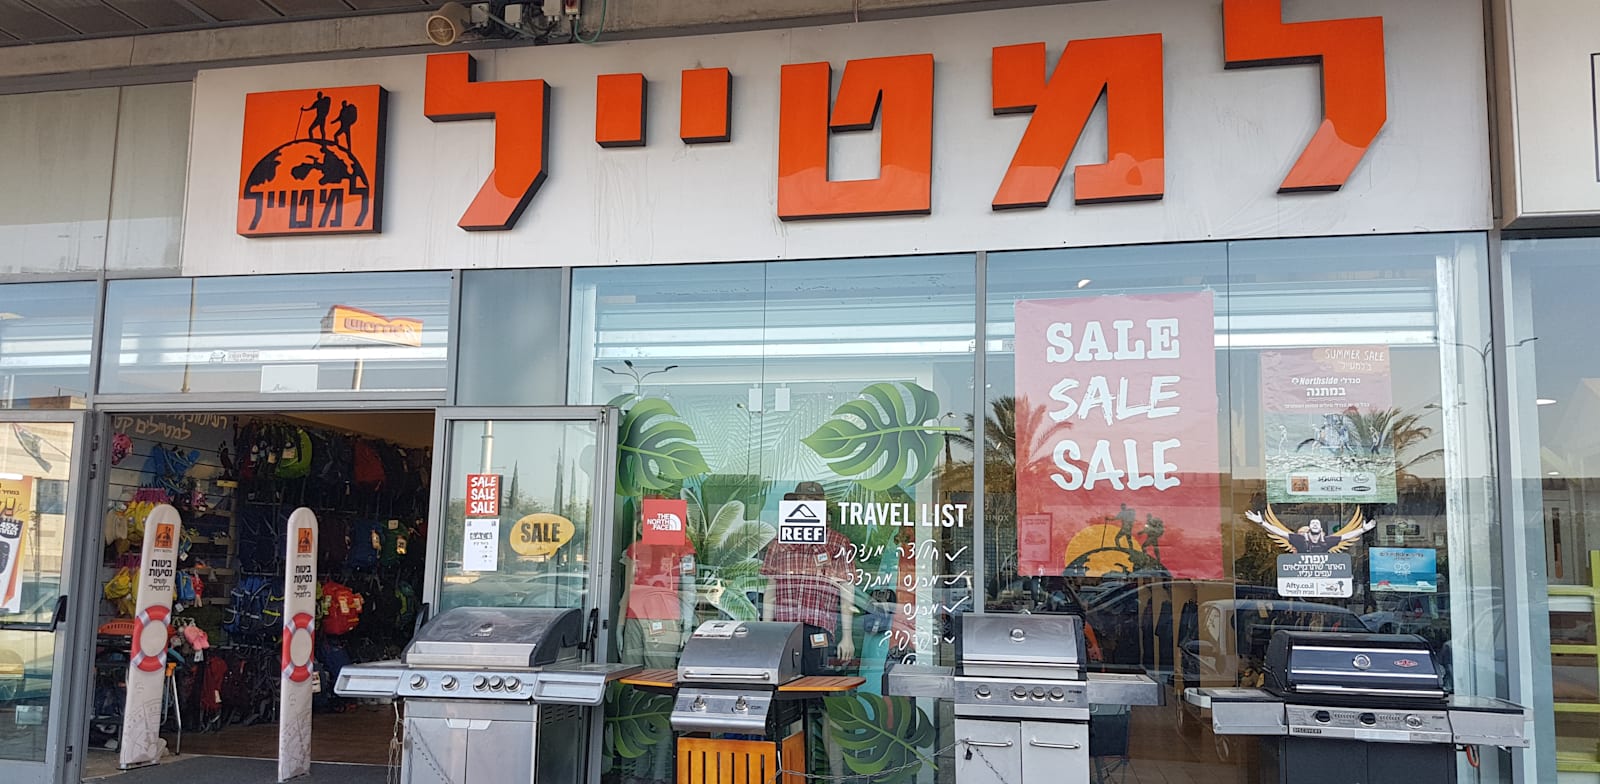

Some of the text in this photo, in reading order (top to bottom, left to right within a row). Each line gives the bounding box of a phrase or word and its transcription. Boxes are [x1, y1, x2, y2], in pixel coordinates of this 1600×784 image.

[424, 0, 1388, 229] למטייל
[243, 176, 369, 231] למטייל
[1046, 318, 1181, 363] SALE
[1325, 348, 1385, 361] SUMMER SALE
[1299, 376, 1339, 386] Northside
[1306, 387, 1346, 396] במתנה
[1049, 375, 1181, 426] SALE
[1050, 438, 1181, 491] SALE
[471, 476, 497, 488] SALE
[471, 488, 496, 501] SALE
[470, 501, 495, 514] SALE
[838, 502, 967, 527] TRAVEL LIST
[520, 523, 560, 543] SALE
[781, 527, 824, 541] REEF
[151, 559, 172, 567] ביטוח
[295, 565, 311, 573] ביטוח
[148, 568, 173, 577] נסיעות
[293, 574, 312, 584] נסיעות
[1286, 582, 1315, 590] Afty.co.il
